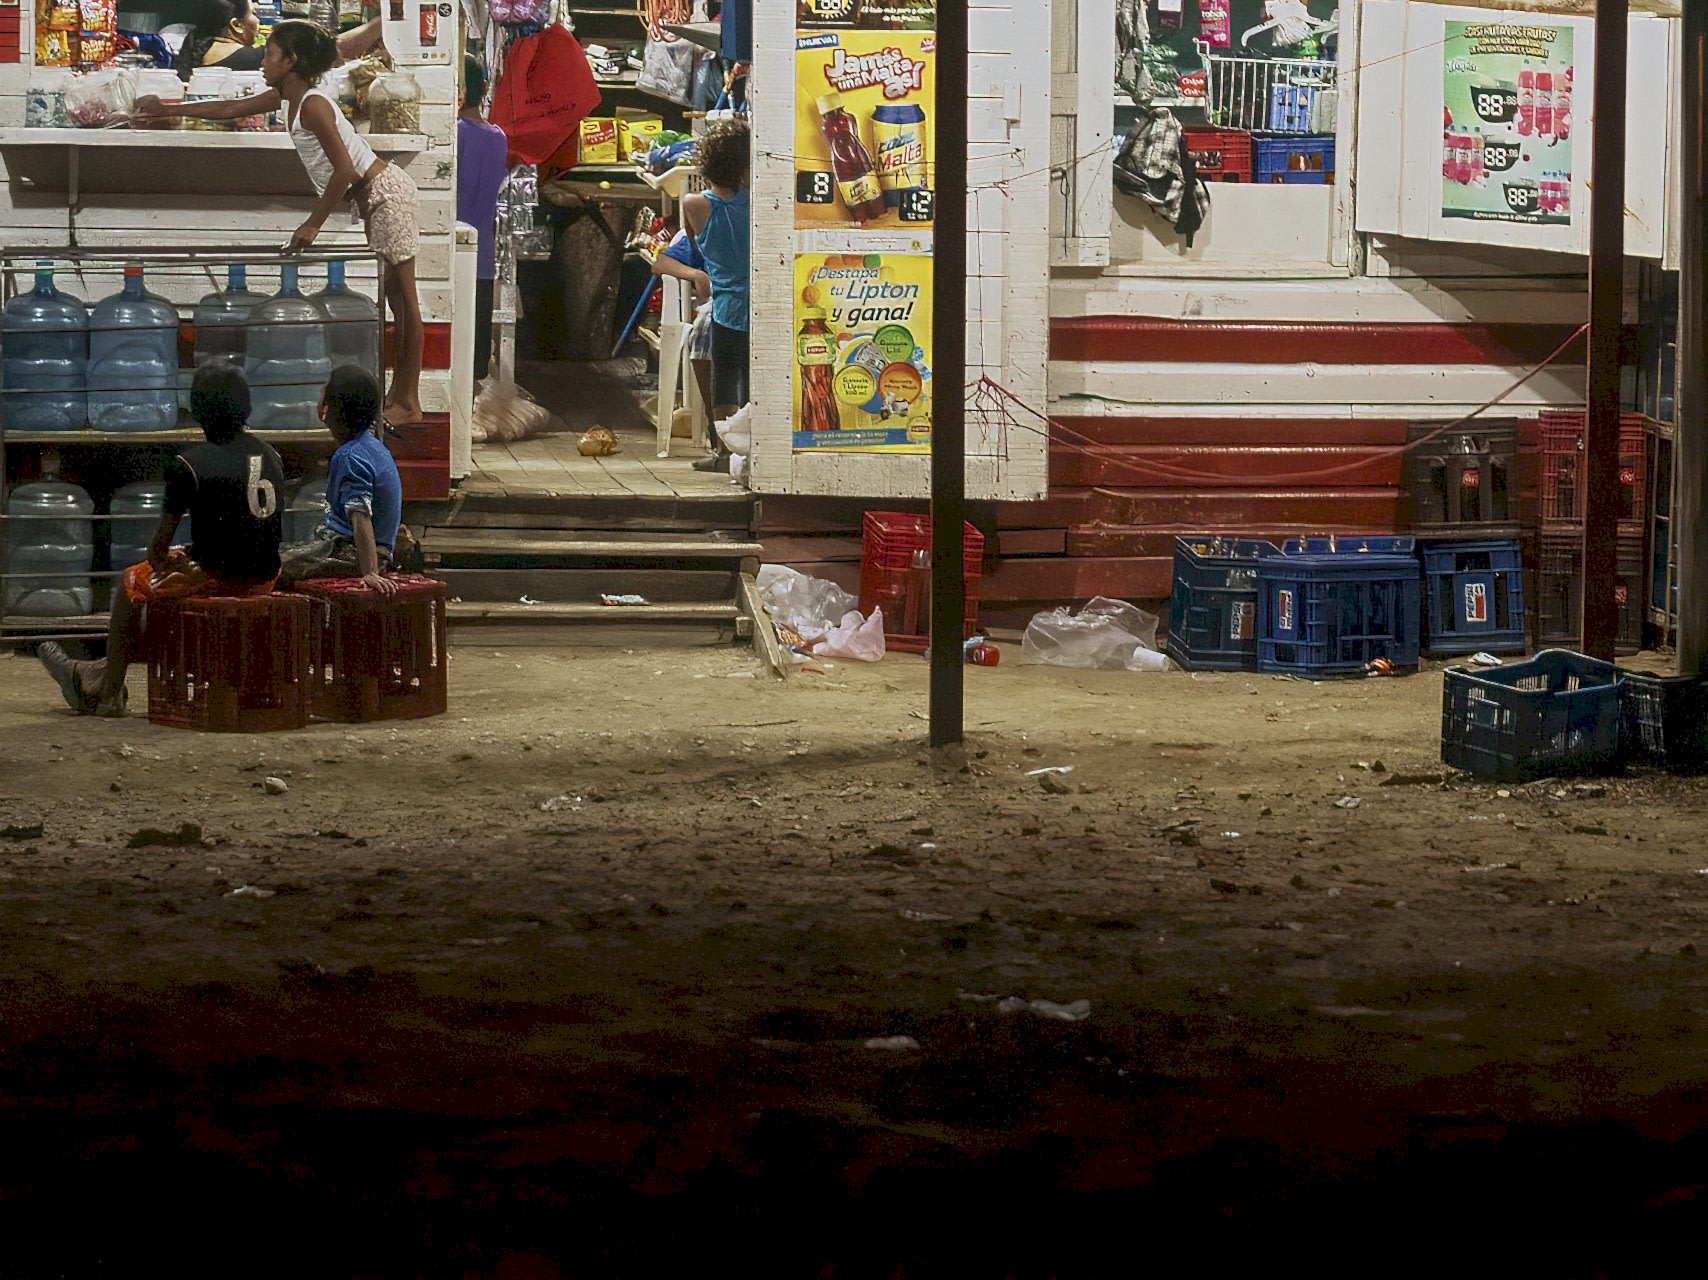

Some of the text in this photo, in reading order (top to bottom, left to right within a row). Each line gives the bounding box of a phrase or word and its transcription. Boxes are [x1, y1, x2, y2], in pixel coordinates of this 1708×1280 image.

[826, 47, 902, 78] Jamás
[861, 58, 913, 85] Malta
[883, 61, 925, 98] así
[814, 172, 829, 195] 8
[811, 266, 879, 283] ¡Destapa
[830, 280, 919, 306] tu Lipton
[830, 301, 914, 328] y gana!
[247, 455, 277, 519] 6
